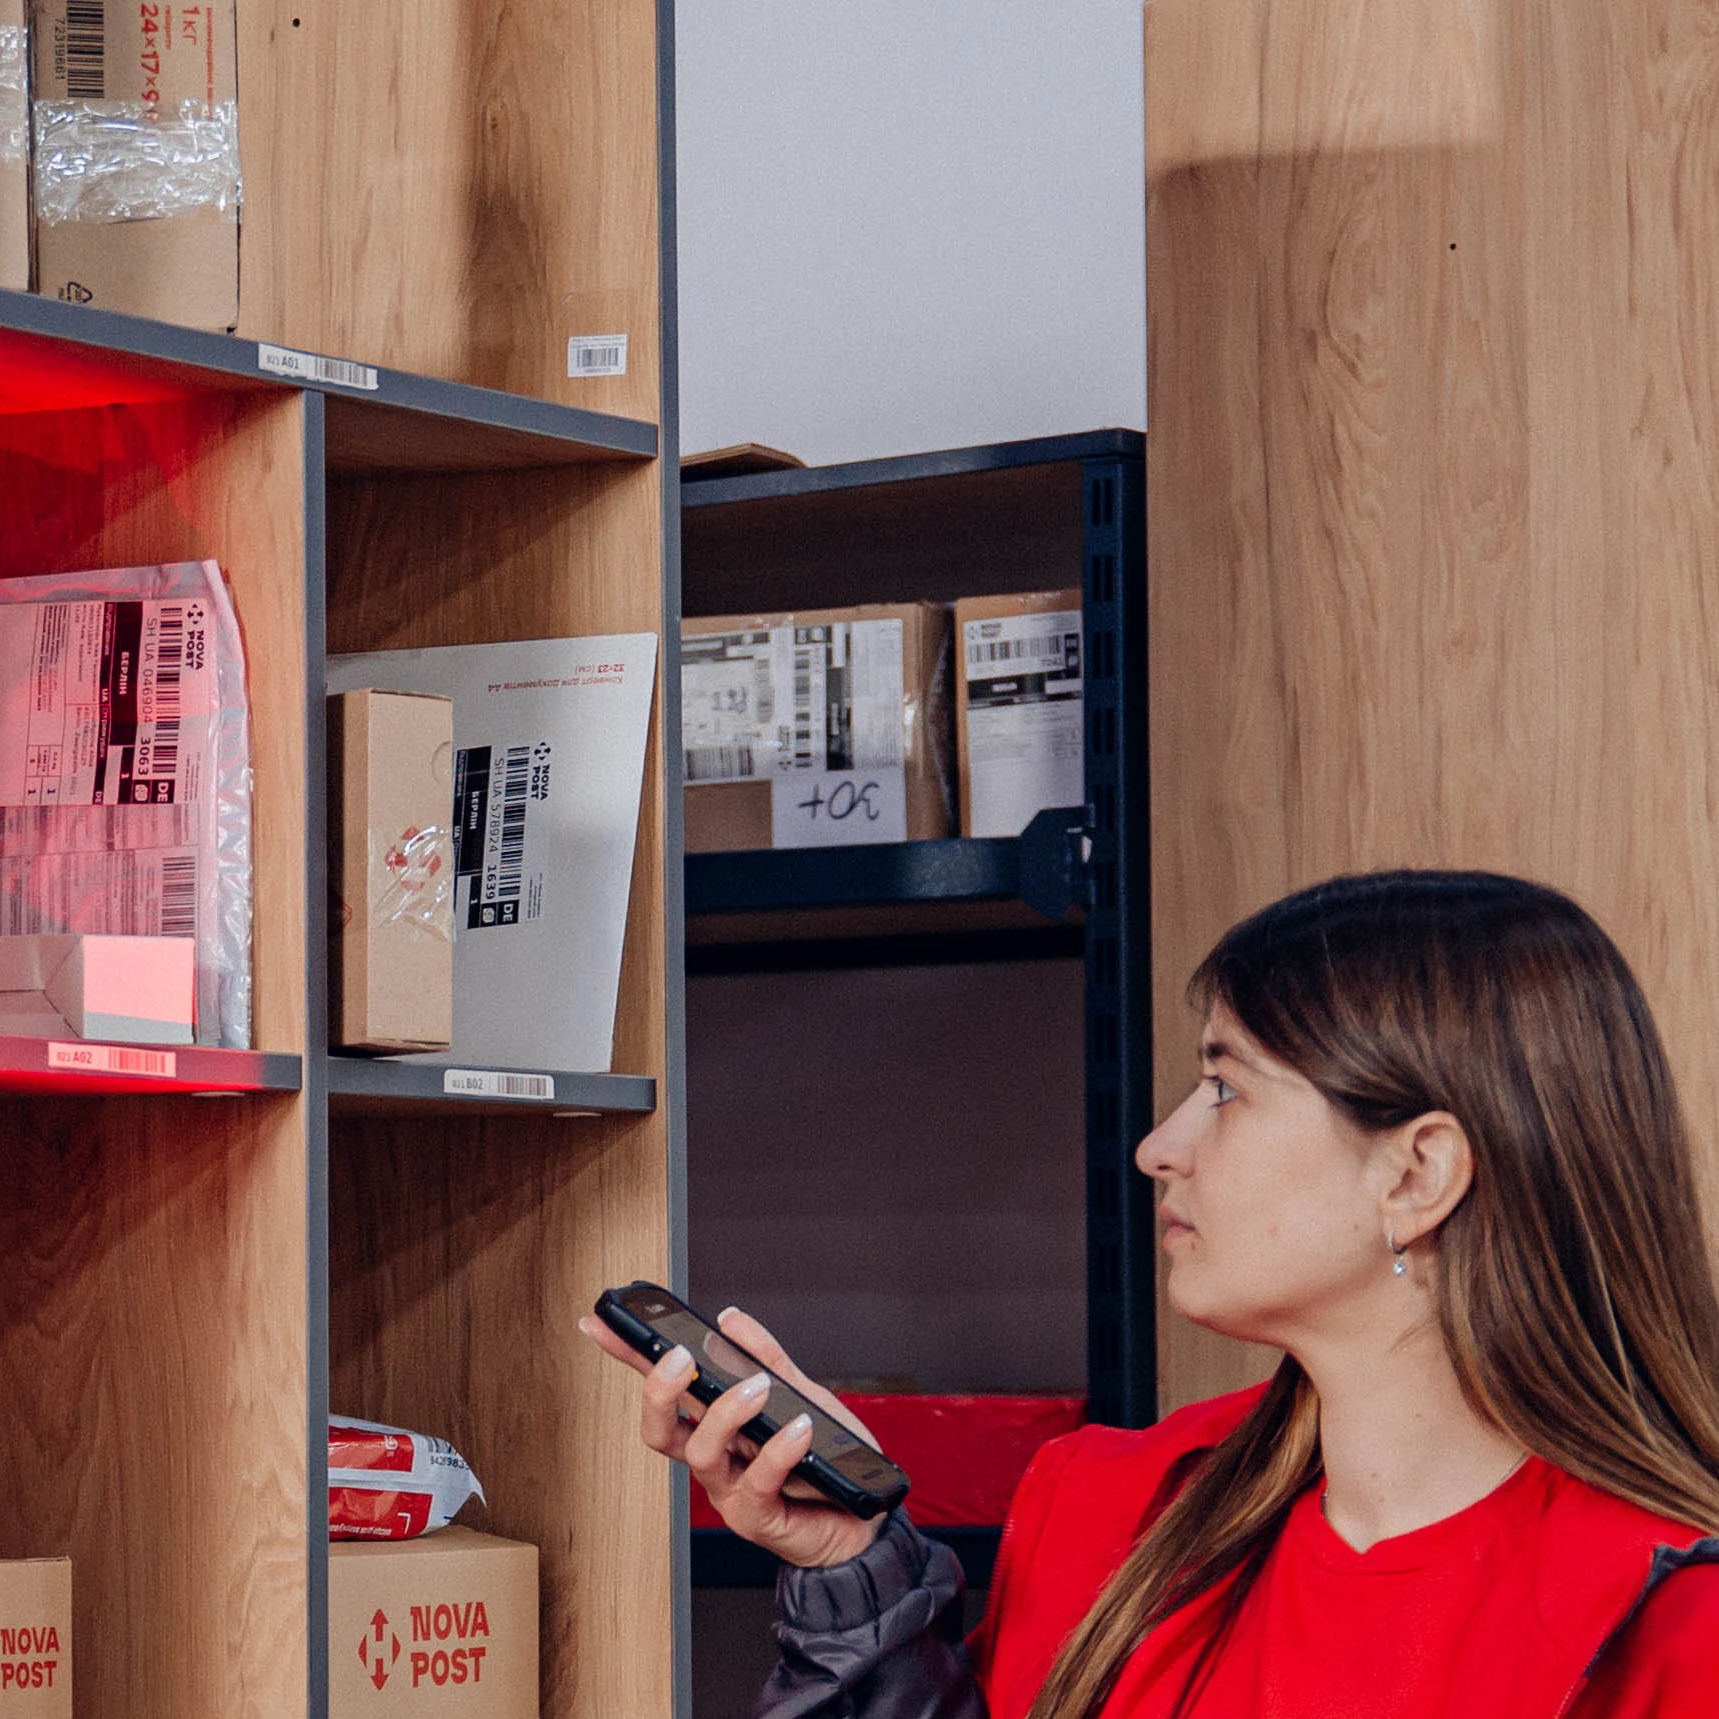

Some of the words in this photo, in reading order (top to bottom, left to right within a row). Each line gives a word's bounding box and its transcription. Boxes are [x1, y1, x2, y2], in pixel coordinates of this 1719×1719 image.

[281, 355, 299, 370] A01
[146, 618, 158, 638] SH
[145, 641, 156, 665] UA
[185, 630, 195, 670] POST
[195, 629, 205, 671] NOVA
[117, 651, 130, 696] БЕРЛІН
[101, 688, 111, 703] UA
[137, 736, 151, 776] 3063
[494, 757, 505, 777] SH
[156, 781, 169, 802] DE
[492, 780, 503, 799] UA
[531, 765, 541, 800] POST
[540, 763, 551, 801] NOVA
[468, 790, 480, 830] БЕРЛІН
[485, 865, 498, 900] 1639
[502, 903, 514, 924] DE
[73, 1051, 93, 1065] A02
[466, 1076, 484, 1090] B02
[409, 1601, 491, 1642] NOVA
[0, 1626, 61, 1655] NOVA
[0, 1660, 58, 1690] POST
[409, 1646, 487, 1688] POST
